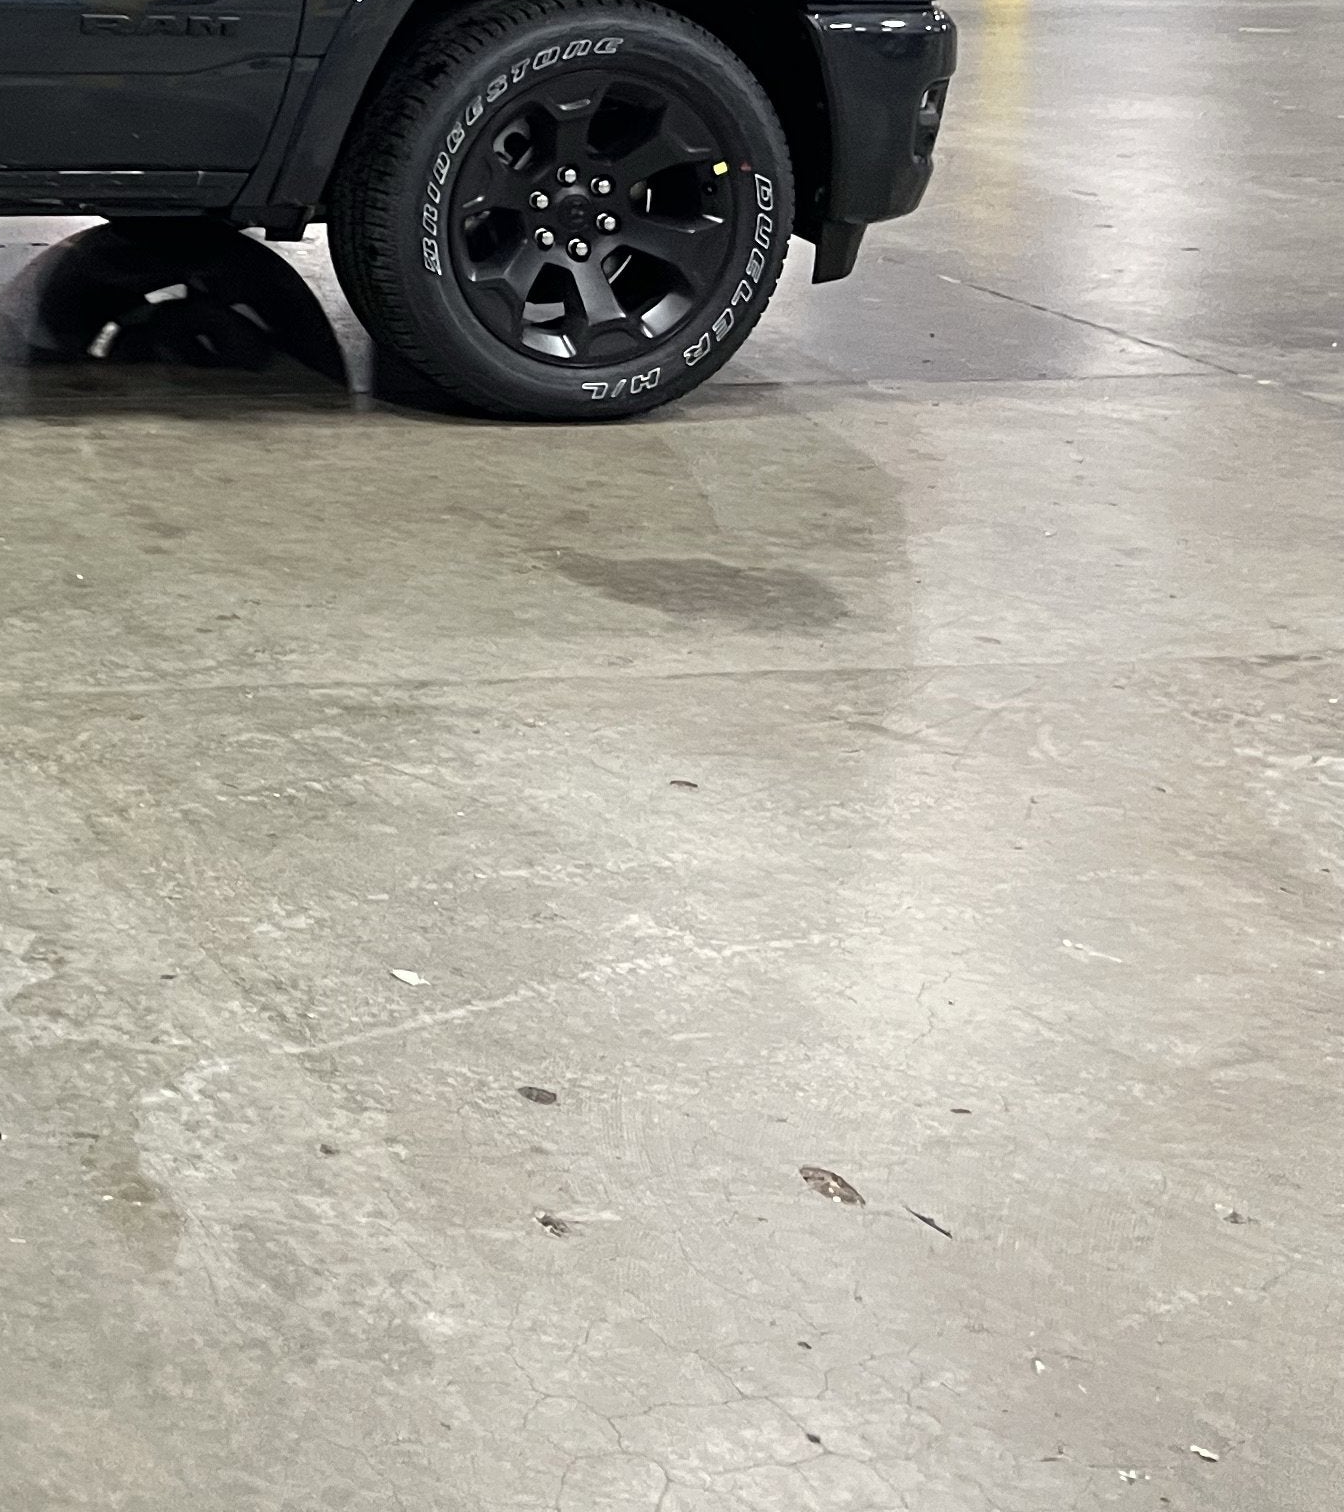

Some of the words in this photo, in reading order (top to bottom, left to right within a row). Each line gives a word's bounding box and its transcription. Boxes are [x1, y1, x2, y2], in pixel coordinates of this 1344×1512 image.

[423, 36, 625, 277] BRIDGESTONE
[683, 173, 774, 366] DUELER
[581, 367, 662, 400] H/L
